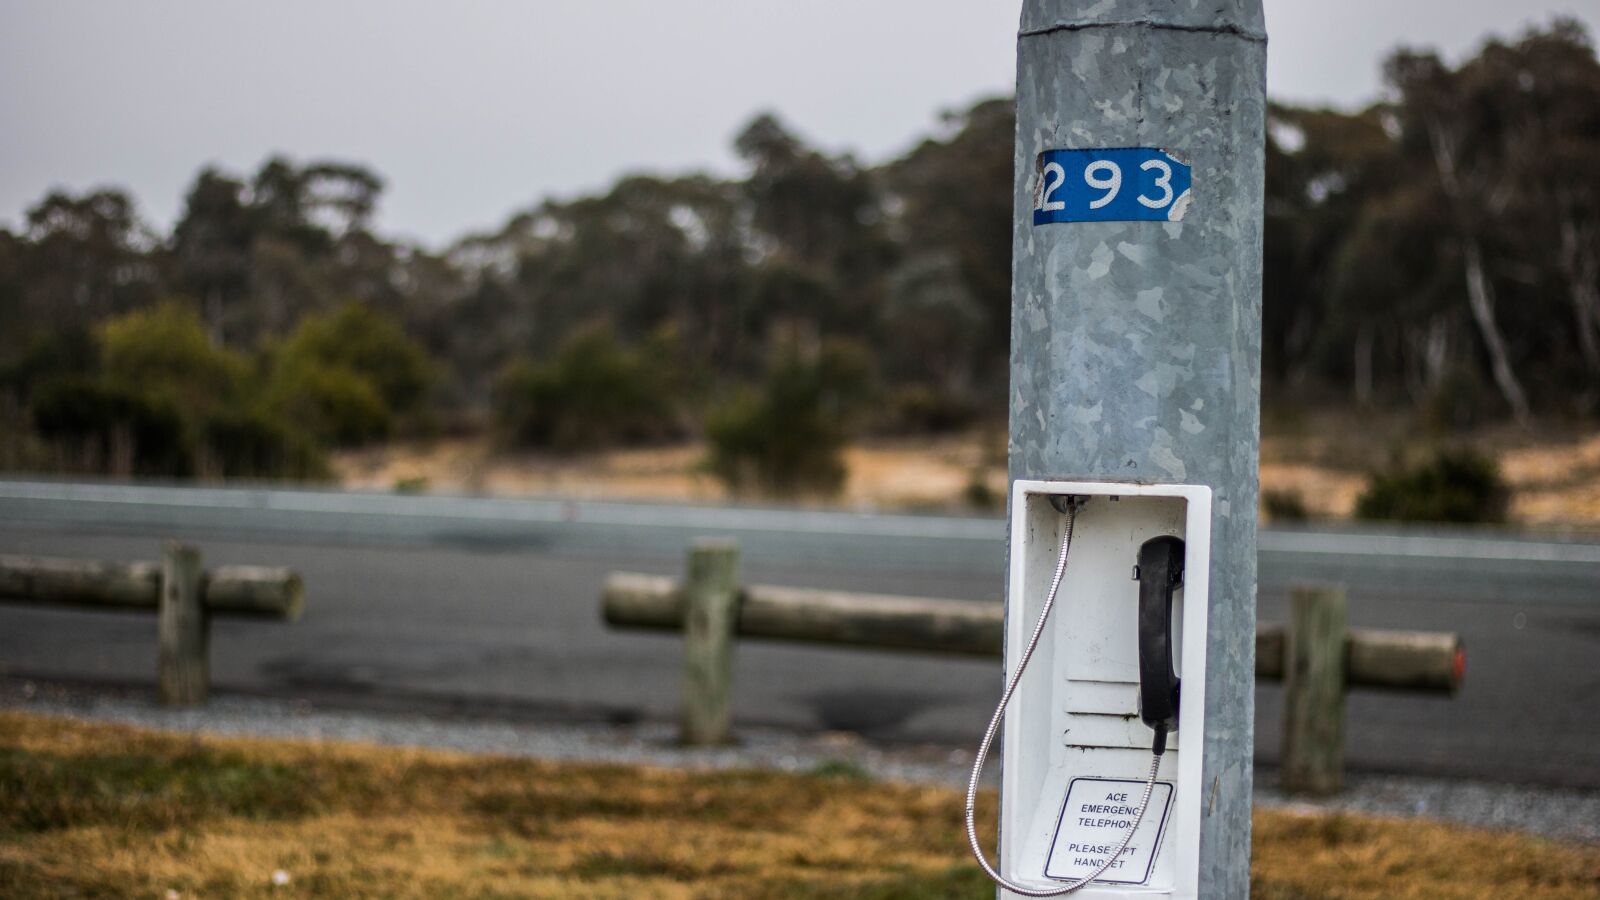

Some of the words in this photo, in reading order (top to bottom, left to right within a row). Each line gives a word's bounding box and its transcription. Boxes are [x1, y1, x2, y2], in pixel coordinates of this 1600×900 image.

[1042, 160, 1174, 211] 293
[1105, 793, 1128, 802] ACE
[1081, 804, 1140, 816] EMERGENC
[1078, 818, 1133, 829] TELEPHON
[1069, 843, 1111, 855] PLEASE
[1115, 846, 1137, 856] FT
[1074, 857, 1126, 869] HANDET
